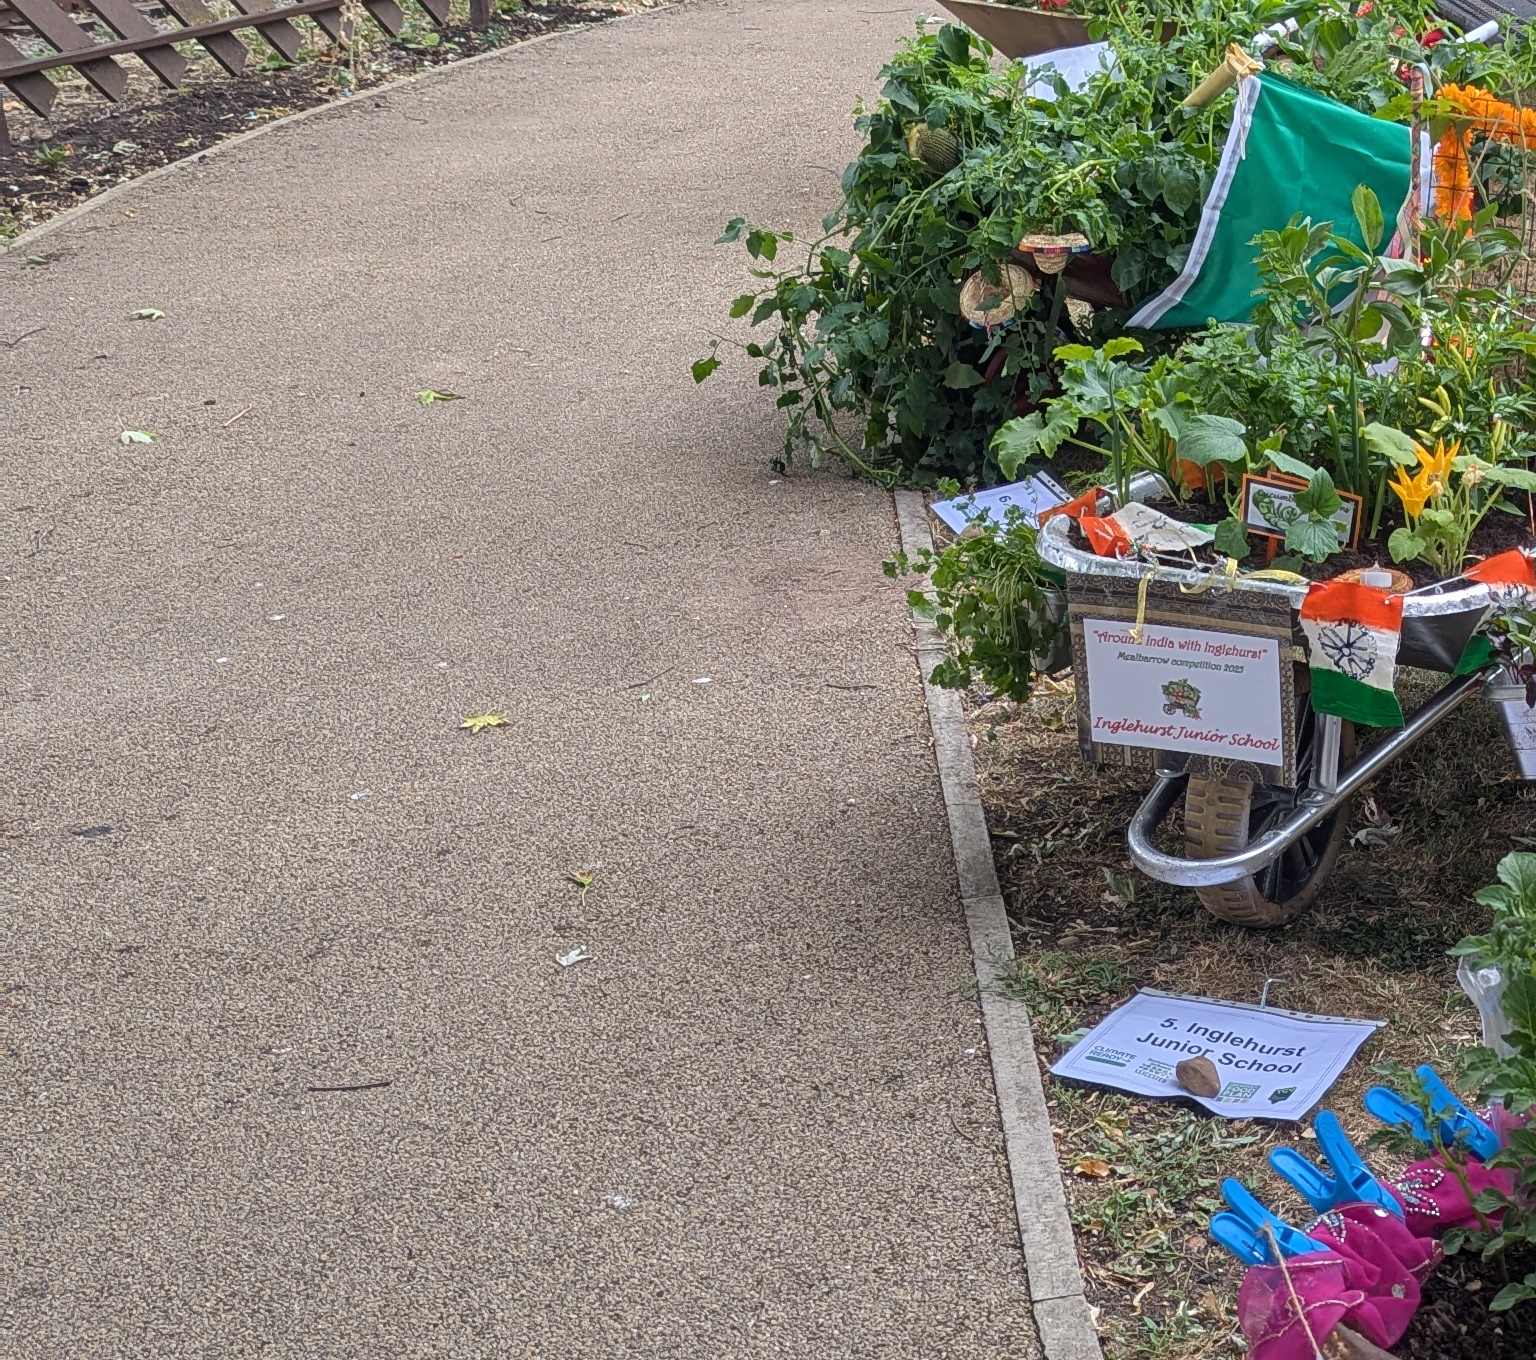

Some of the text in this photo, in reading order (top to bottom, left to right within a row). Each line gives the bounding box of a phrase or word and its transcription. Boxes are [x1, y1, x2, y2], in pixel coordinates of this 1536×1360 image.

[1146, 635, 1175, 649] India
[1178, 640, 1202, 652] with
[1171, 658, 1222, 671] competition
[1223, 663, 1245, 674] 2025
[1093, 716, 1280, 752] Inglehurst Junior School
[1160, 1017, 1306, 1058] 5. Inglehurst
[1089, 1049, 1121, 1061] READY
[1094, 1045, 1138, 1060] CLIMATE
[1136, 1032, 1303, 1075] Junior School
[1221, 1090, 1252, 1098] PLAN
[1228, 1085, 1256, 1094] FOOD
